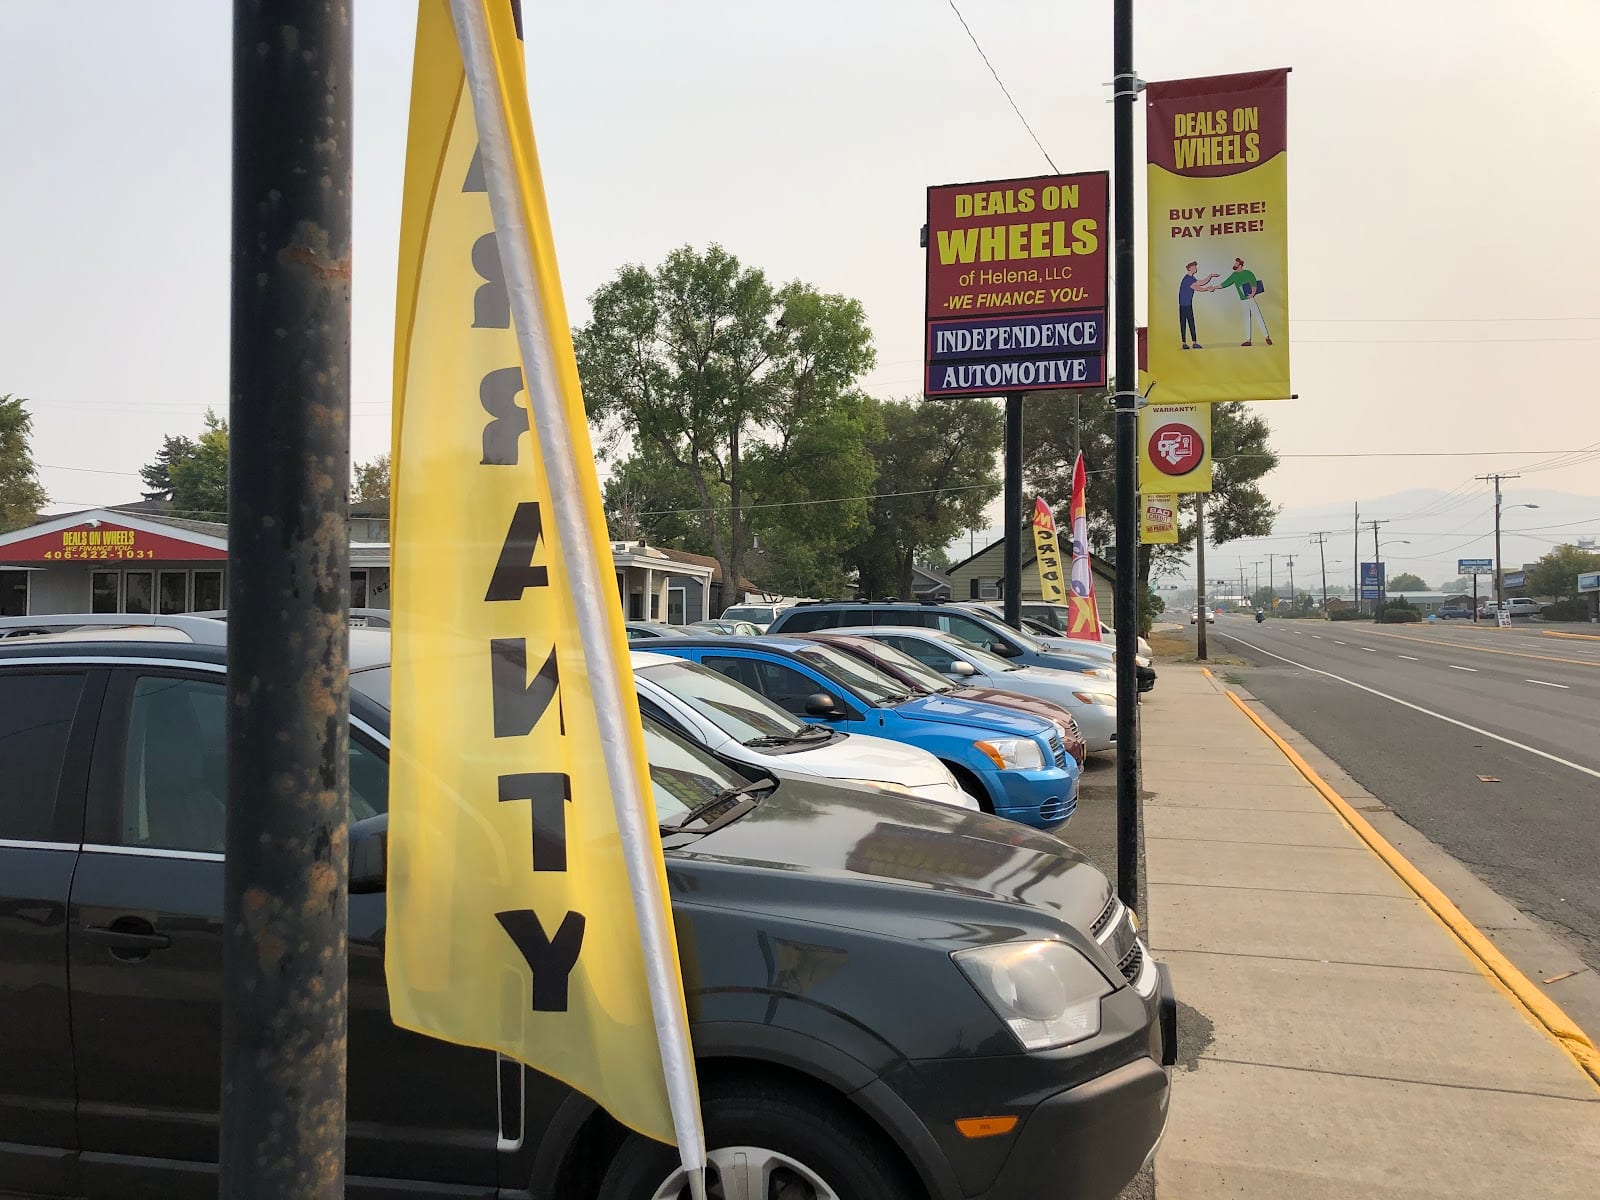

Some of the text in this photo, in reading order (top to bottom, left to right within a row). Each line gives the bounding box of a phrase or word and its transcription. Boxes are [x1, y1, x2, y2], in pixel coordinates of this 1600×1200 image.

[1174, 106, 1258, 137] DEALS ON
[1173, 132, 1260, 170] WHEELS
[955, 184, 1079, 218] DEALS ON
[1169, 201, 1266, 221] BUY HERE!
[1171, 219, 1264, 239] PAY HERE!
[936, 218, 1098, 265] WHEELS
[959, 266, 1073, 286] of Helena, LLC
[943, 287, 1089, 310] -WE FINANCE YOU-
[936, 321, 1098, 353] INDEPENDENCE
[941, 358, 1088, 389] AUTOMOTIVE
[1149, 508, 1170, 517] BAD
[63, 531, 135, 546] DEALS ON WHEELS
[44, 550, 154, 559] 406-422-1031
